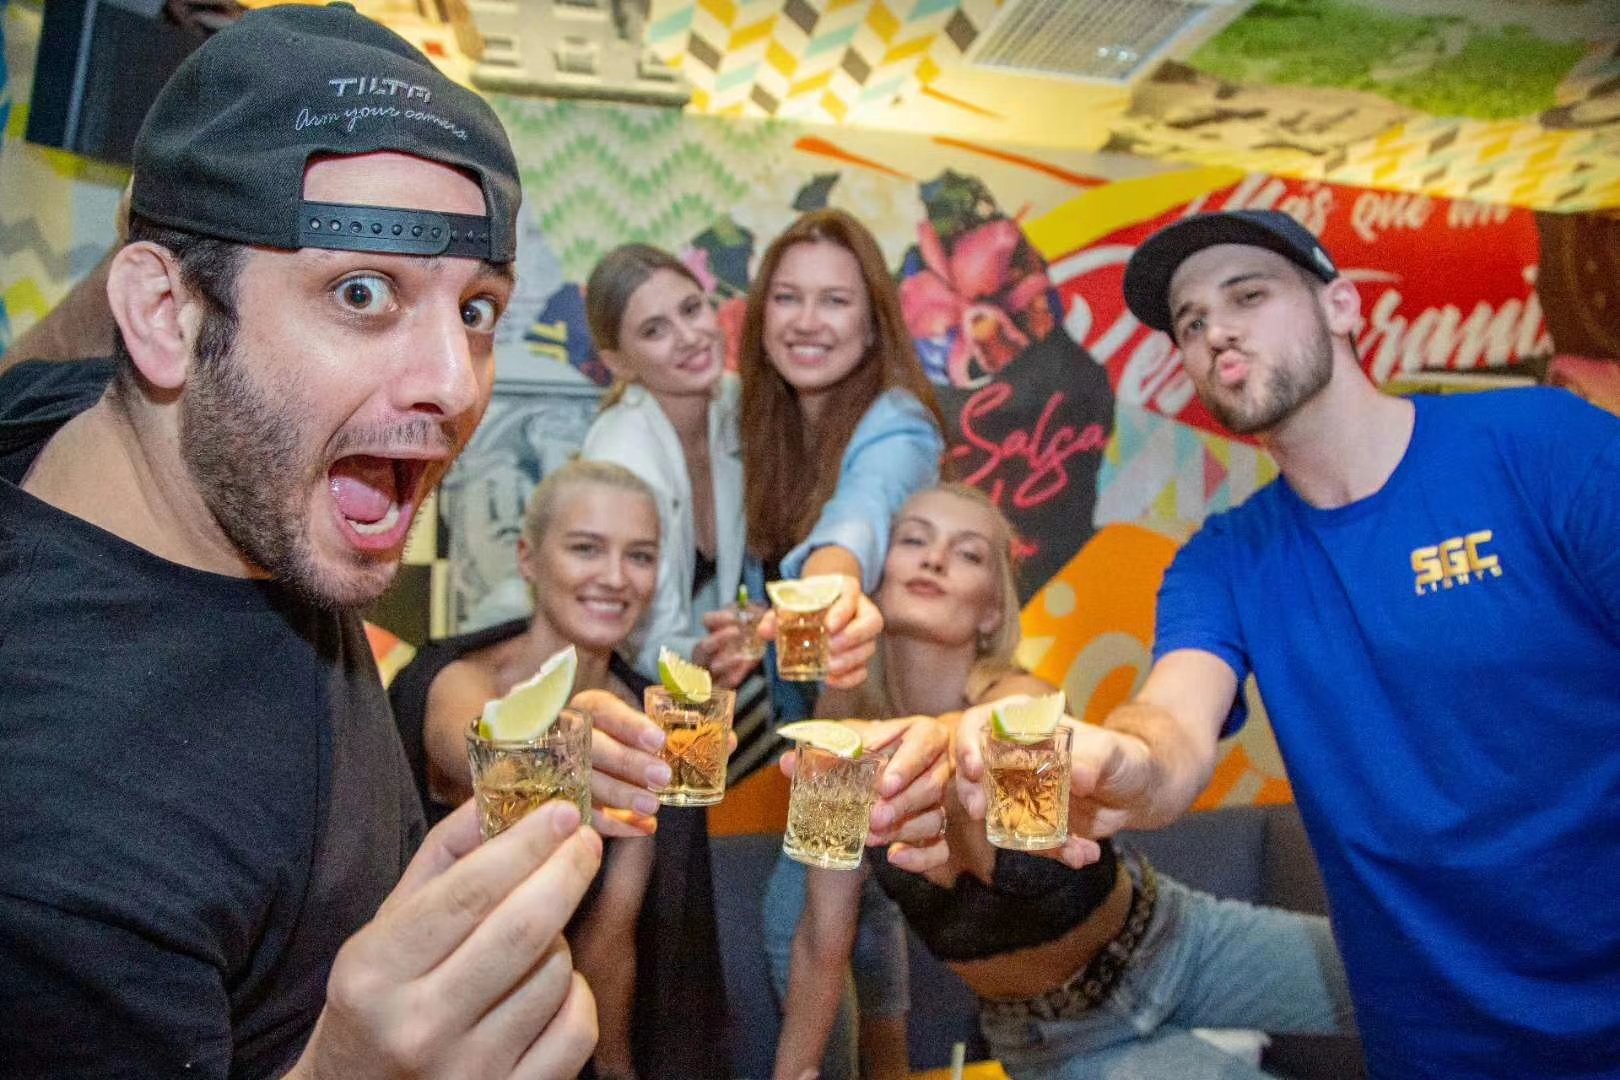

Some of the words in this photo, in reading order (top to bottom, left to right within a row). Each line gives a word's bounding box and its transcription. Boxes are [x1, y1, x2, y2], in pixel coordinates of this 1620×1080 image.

[344, 106, 400, 132] your
[960, 382, 1108, 509] Salsa
[1411, 529, 1498, 585] SGC
